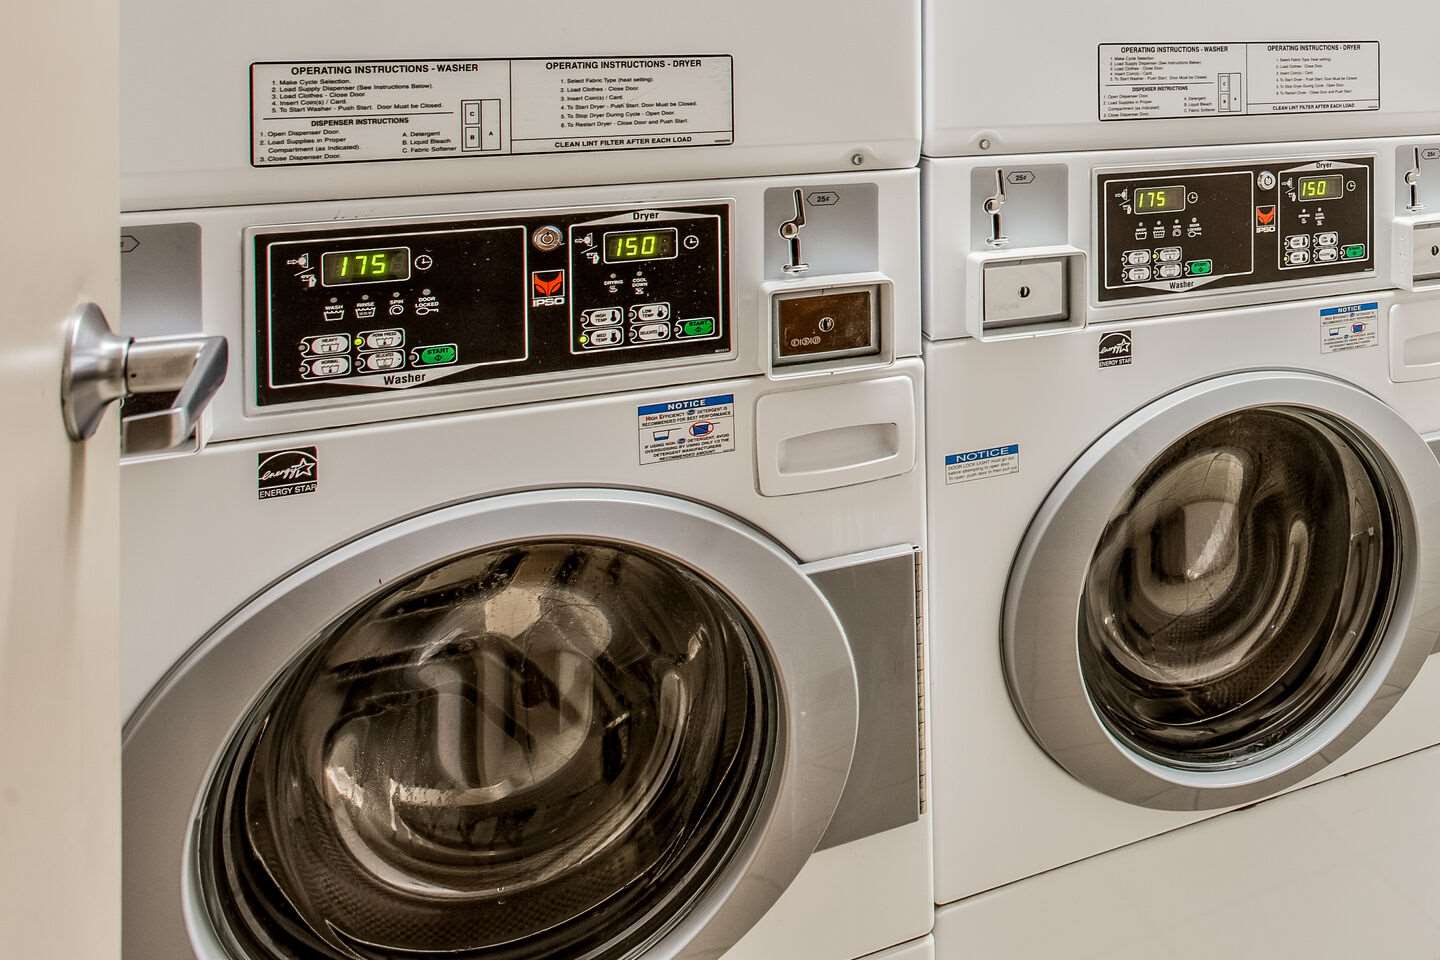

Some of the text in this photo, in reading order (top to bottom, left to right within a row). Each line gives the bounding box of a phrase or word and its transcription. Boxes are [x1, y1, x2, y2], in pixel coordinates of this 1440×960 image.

[291, 63, 479, 75] OPERATING INSTRUCTIONS WASHER
[545, 59, 702, 70] OPERATING INSTRUCTIONS DRYER
[355, 117, 410, 126] INSTRUCTIONS
[1315, 161, 1332, 169] Dryer
[1302, 180, 1326, 196] 150
[1138, 191, 1165, 208] 175
[632, 211, 660, 221] Dryer
[616, 236, 656, 257] 150
[339, 253, 387, 278] 175
[1169, 280, 1195, 289] Washer
[532, 297, 565, 307] IPSO
[426, 346, 450, 355] START
[383, 371, 427, 386] Washer
[667, 399, 706, 411] NOTICE
[956, 447, 1009, 463] NOTICE
[259, 483, 317, 499] ENERGY STAR
